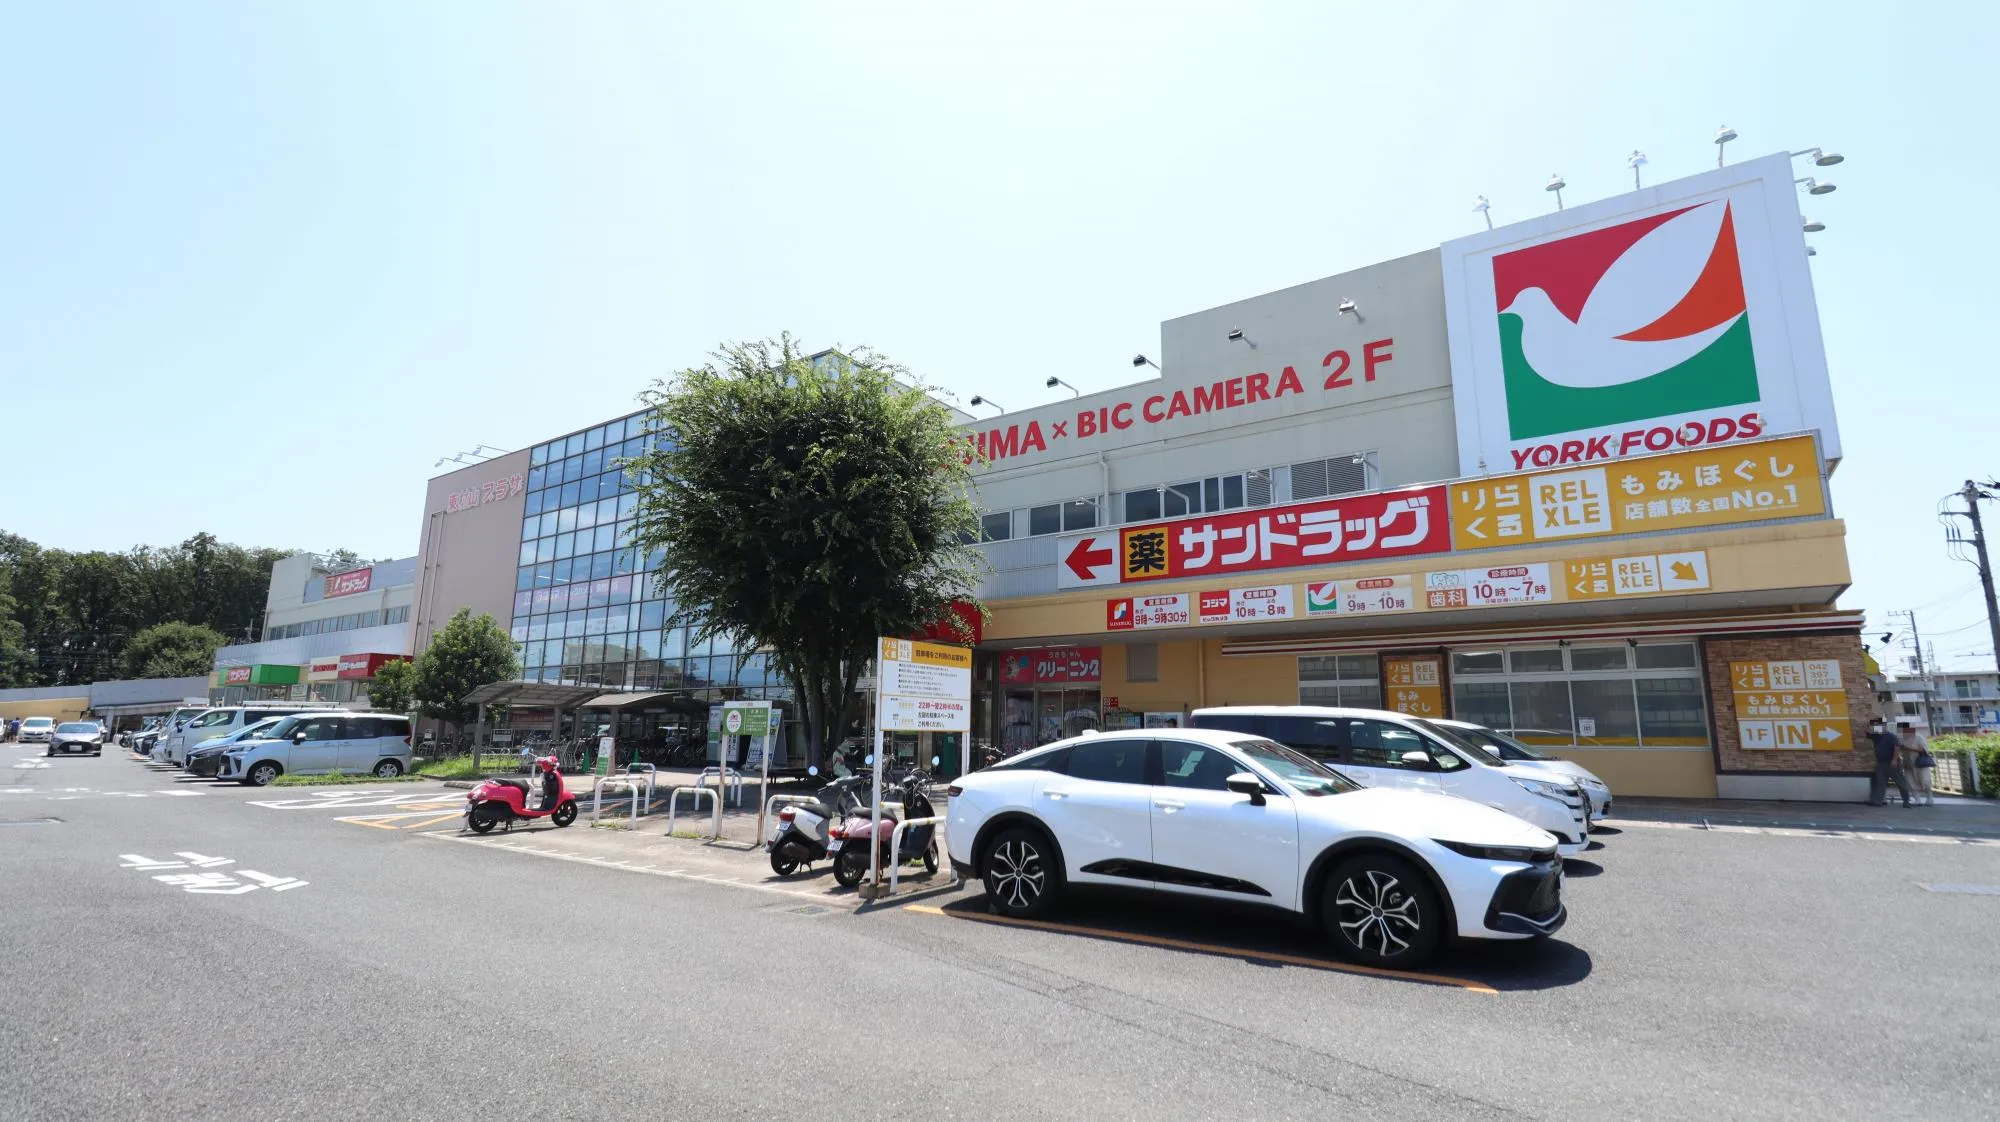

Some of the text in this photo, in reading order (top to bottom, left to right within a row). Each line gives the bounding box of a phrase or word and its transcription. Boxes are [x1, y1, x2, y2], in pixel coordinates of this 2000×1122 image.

[950, 420, 1047, 465] JIMA
[1077, 402, 1134, 438] BIC
[1143, 365, 1304, 423] CAMERA
[1510, 412, 1762, 470] YORK FOODS
[1620, 456, 1795, 496] もみほぐし
[1462, 485, 1520, 511] りら
[1540, 480, 1598, 505] REL
[1625, 485, 1798, 521] 店舗数全国No.1
[1543, 502, 1601, 528] XLE
[1129, 496, 1430, 573] 薬 サンドラッグ
[1466, 514, 1523, 539] くる
[1618, 561, 1651, 575] REL
[1620, 575, 1653, 588] XLE
[1202, 598, 1228, 608] コジマ
[1430, 590, 1464, 607] 歯科
[1037, 659, 1099, 678] クリーニング
[1773, 664, 1799, 675] REL
[1774, 675, 1801, 686] XLE
[1745, 728, 1769, 741] 1F
[1777, 725, 1810, 744] IN
